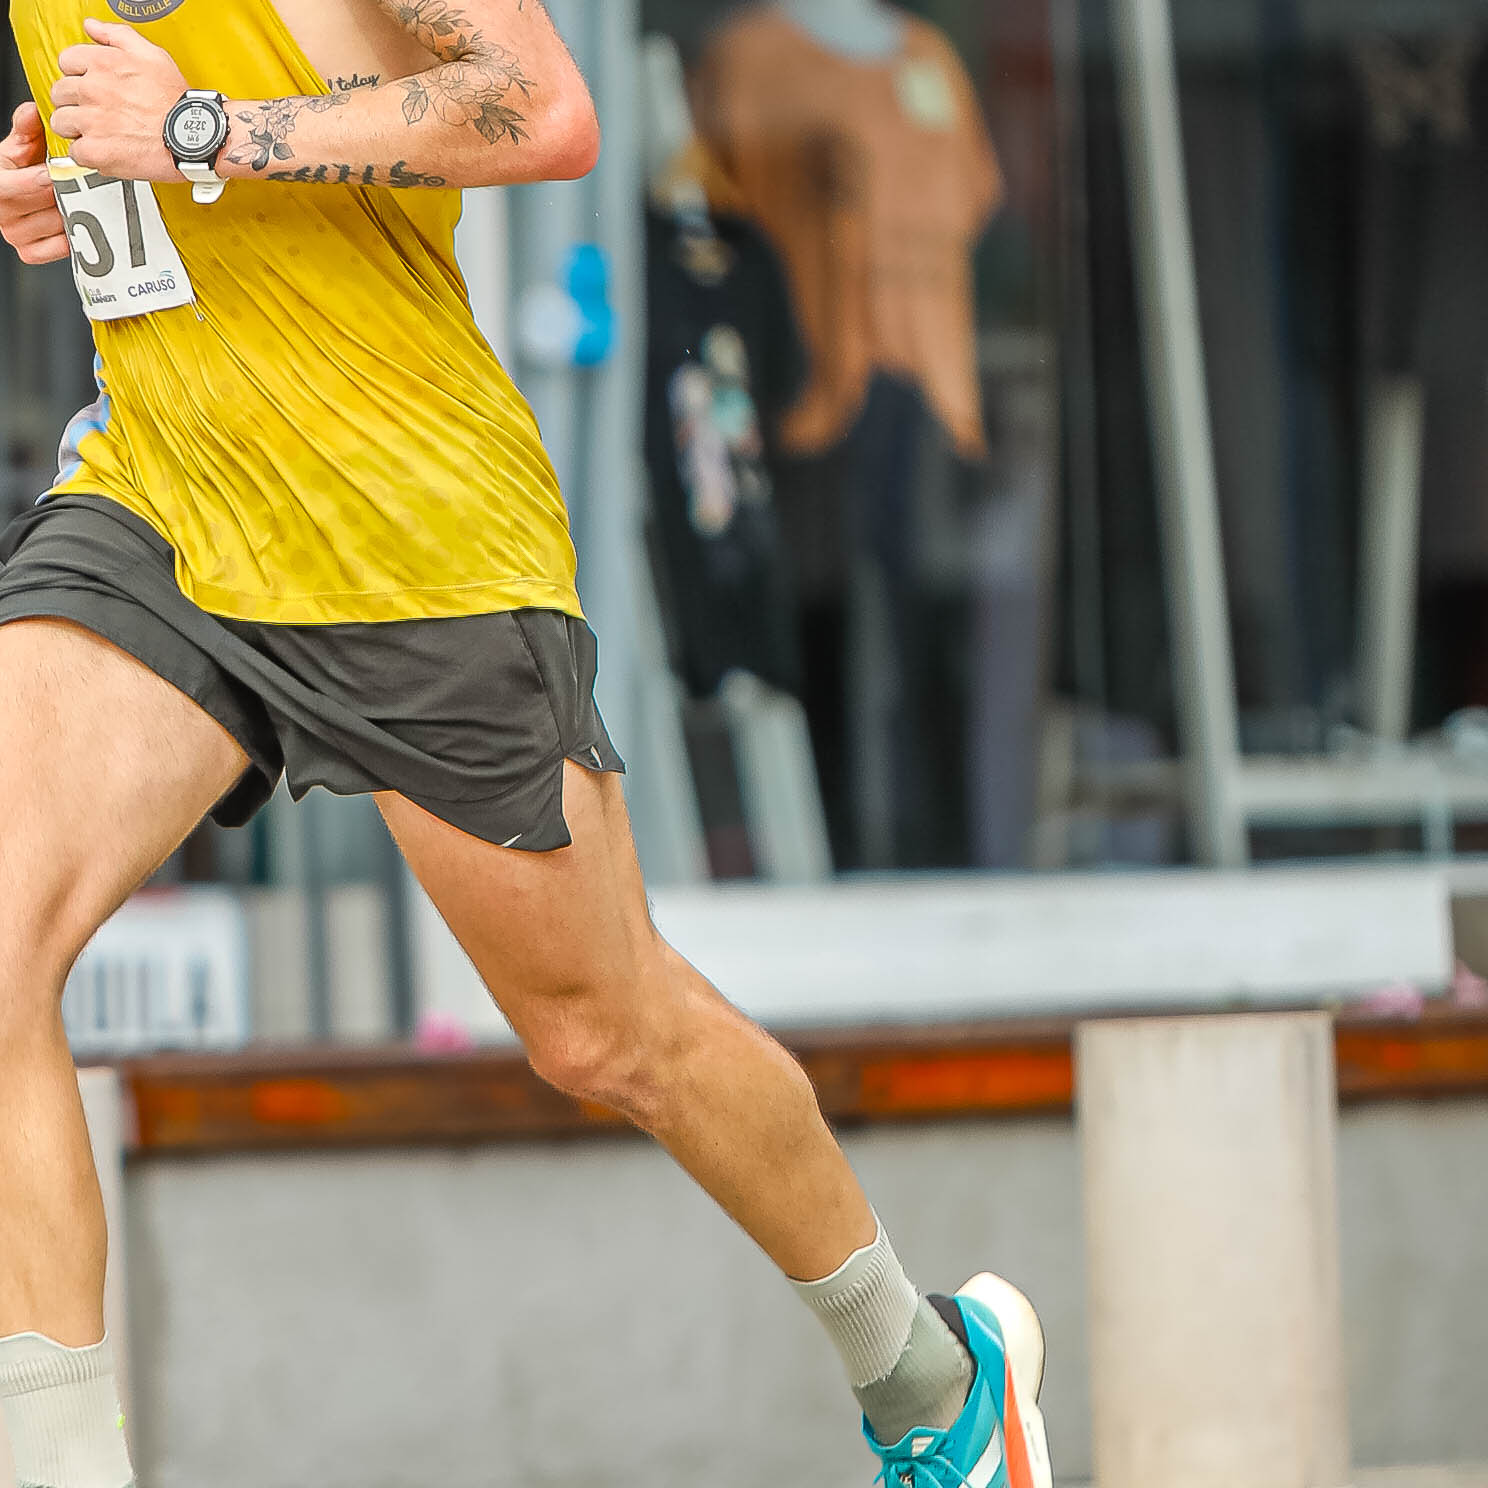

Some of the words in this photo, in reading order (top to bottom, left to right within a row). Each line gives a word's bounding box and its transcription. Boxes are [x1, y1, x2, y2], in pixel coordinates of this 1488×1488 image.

[117, 0, 142, 17] BELL
[336, 73, 380, 91] today
[53, 172, 146, 278] 57
[127, 278, 176, 298] CARUSO
